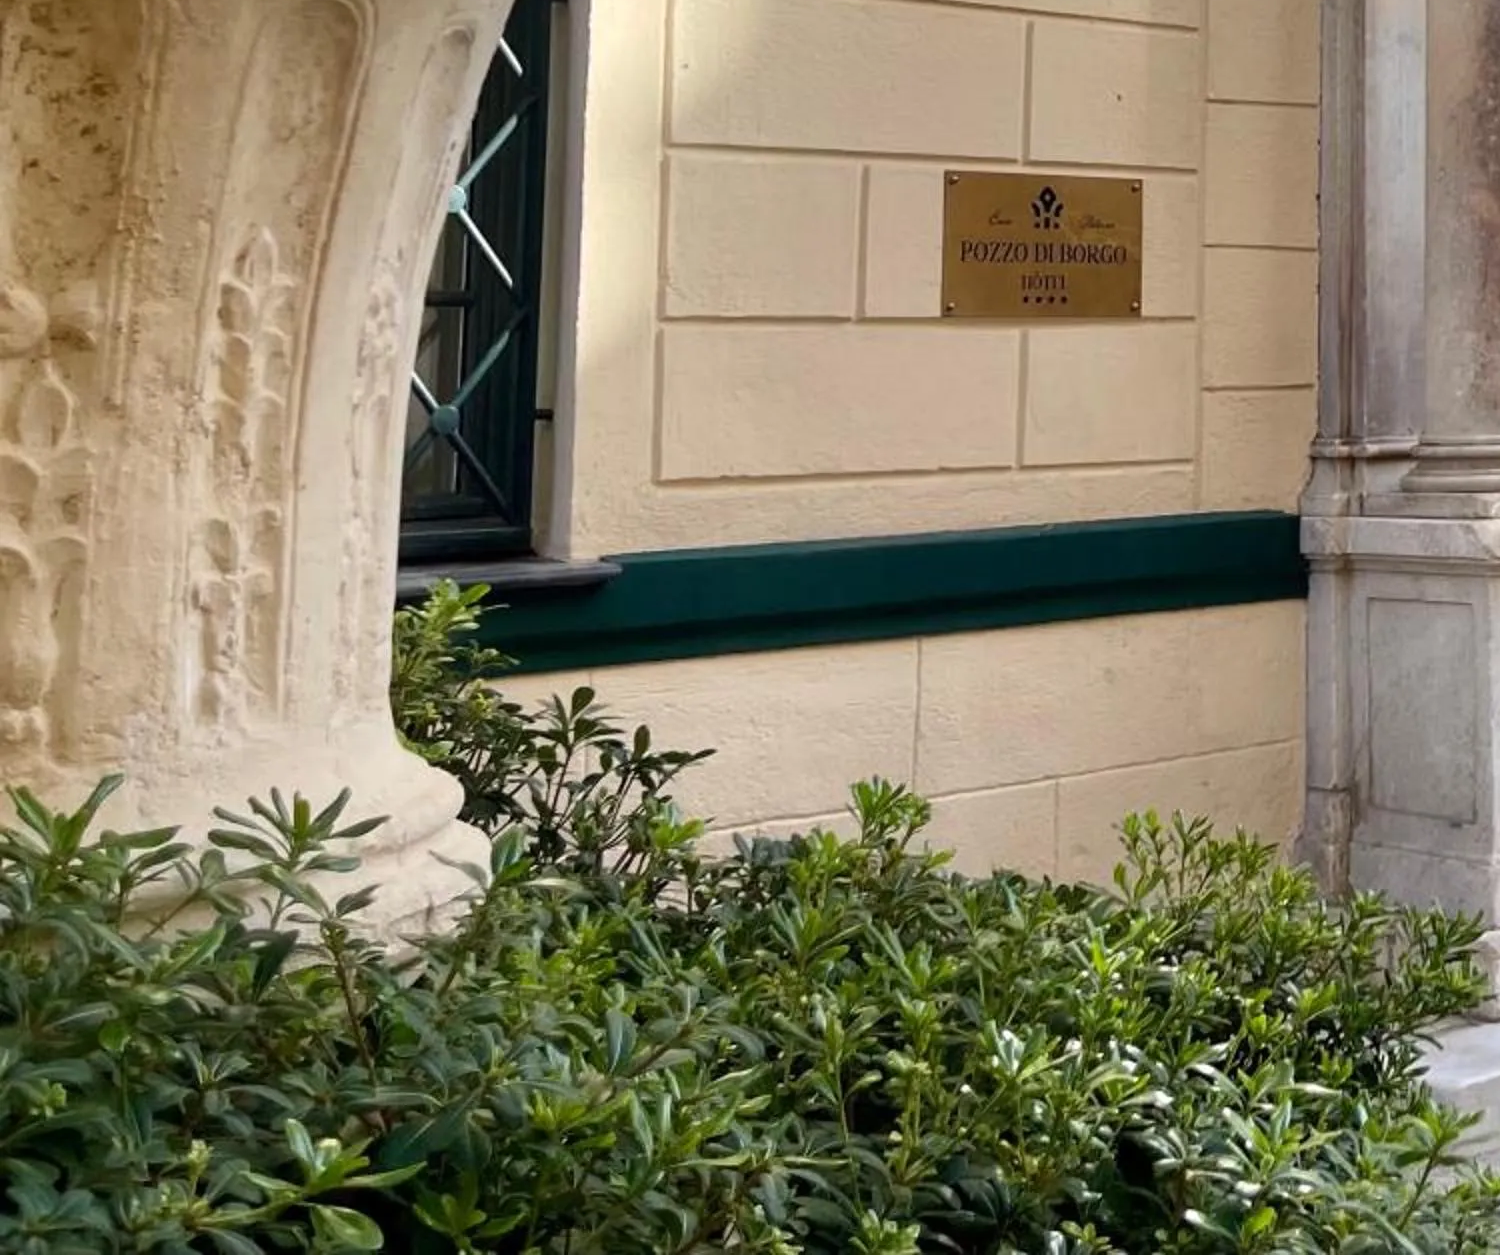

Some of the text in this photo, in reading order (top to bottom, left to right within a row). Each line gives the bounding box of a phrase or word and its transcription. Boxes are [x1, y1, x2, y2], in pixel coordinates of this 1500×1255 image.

[960, 240, 1127, 265] POZZO DI BORGO
